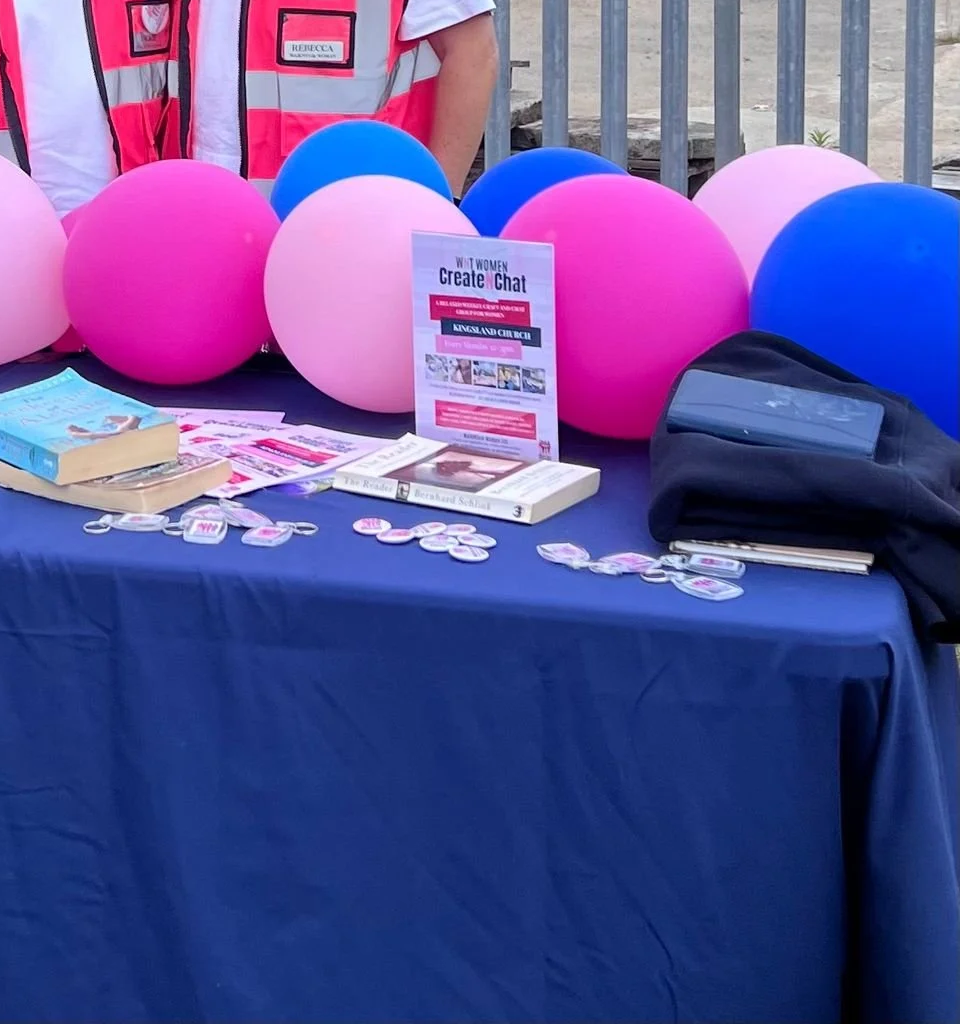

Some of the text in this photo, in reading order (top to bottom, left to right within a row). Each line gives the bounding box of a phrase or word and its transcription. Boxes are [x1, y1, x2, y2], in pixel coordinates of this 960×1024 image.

[292, 44, 334, 52] REBECCA
[476, 258, 508, 273] WOMEN
[453, 323, 531, 340] KINGSLAND CHURCH
[343, 476, 360, 488] The
[362, 479, 394, 494] Reader
[414, 489, 456, 504] Bernhard
